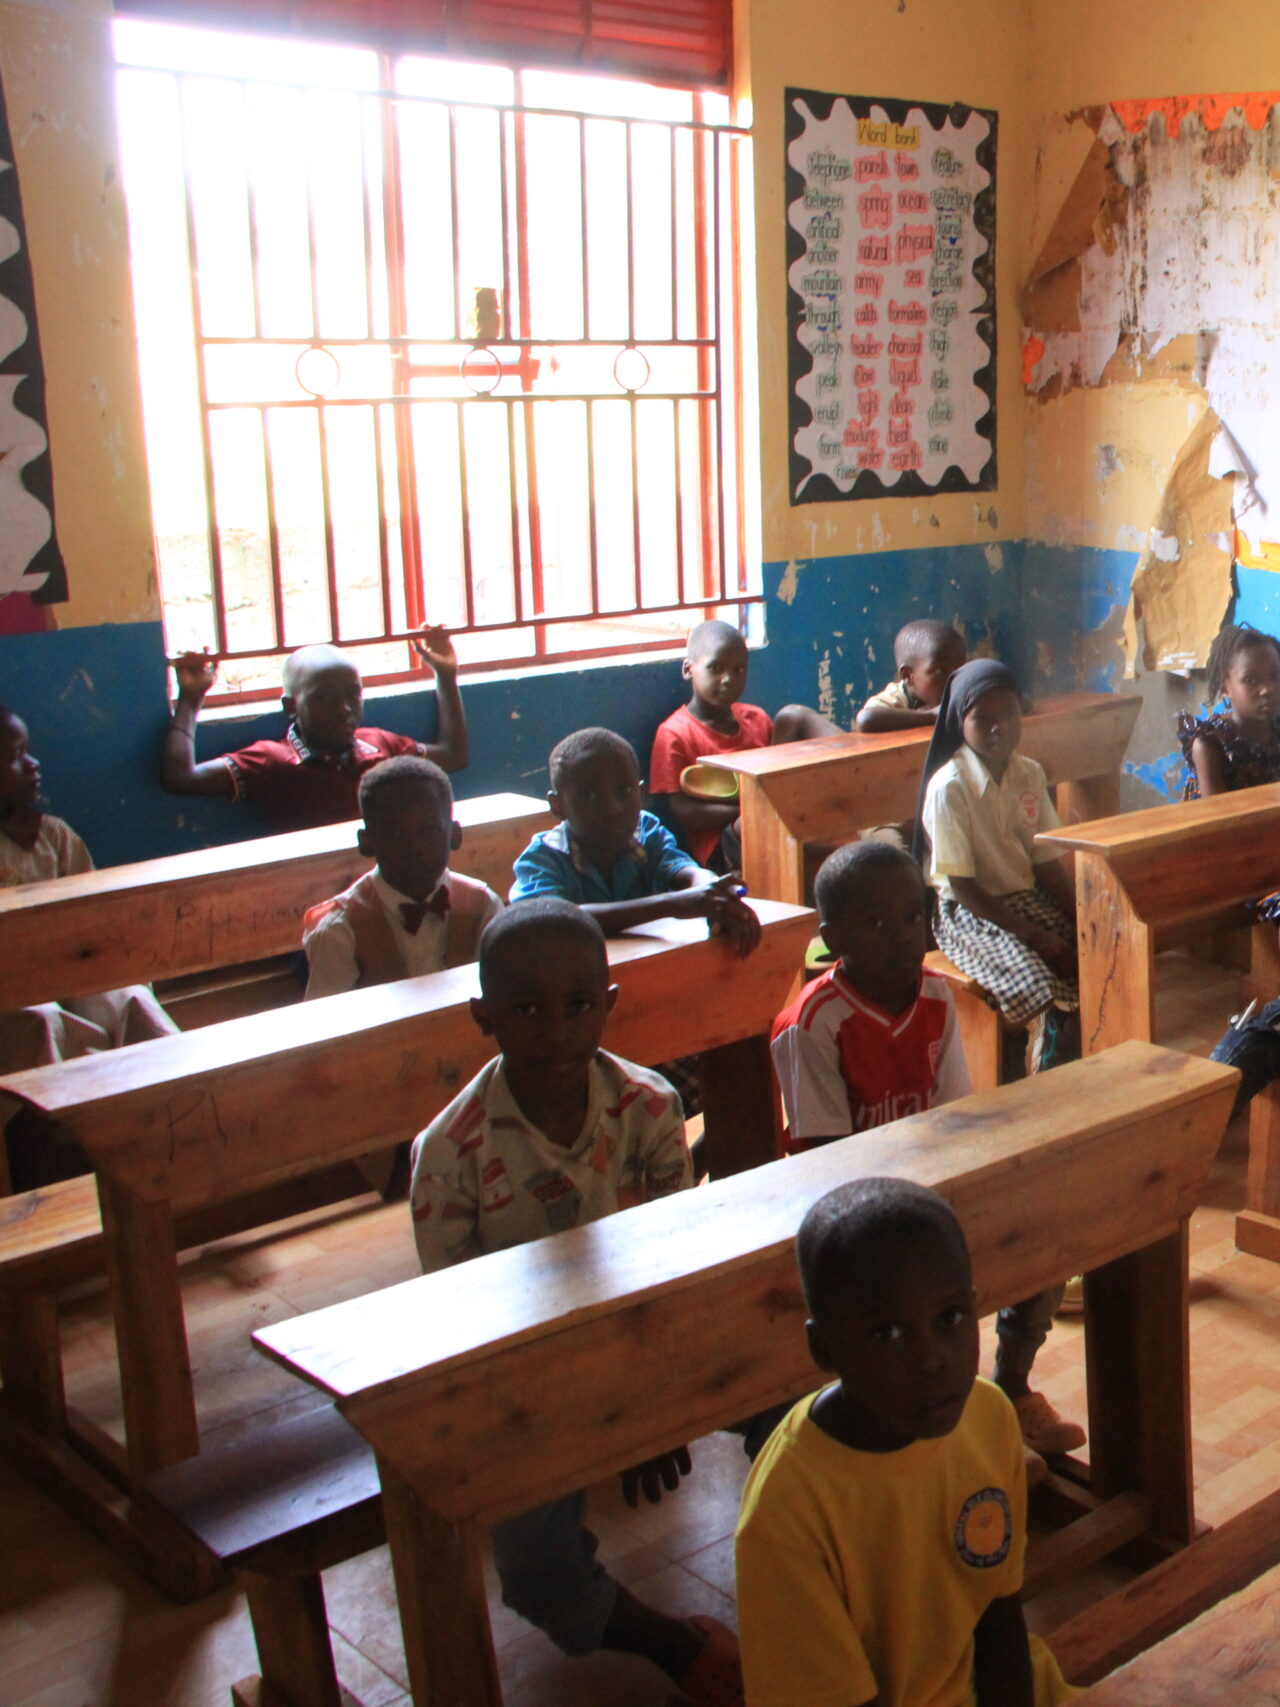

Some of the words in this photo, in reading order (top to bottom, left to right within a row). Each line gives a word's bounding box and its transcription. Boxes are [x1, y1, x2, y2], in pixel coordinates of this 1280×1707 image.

[859, 123, 886, 143] Word
[895, 126, 916, 144] bank
[804, 191, 843, 208] between
[859, 194, 889, 223] spring
[859, 236, 888, 261] natural
[803, 272, 841, 288] mountain
[906, 272, 921, 284] sea
[813, 335, 841, 363] valley
[891, 444, 922, 467] earth
